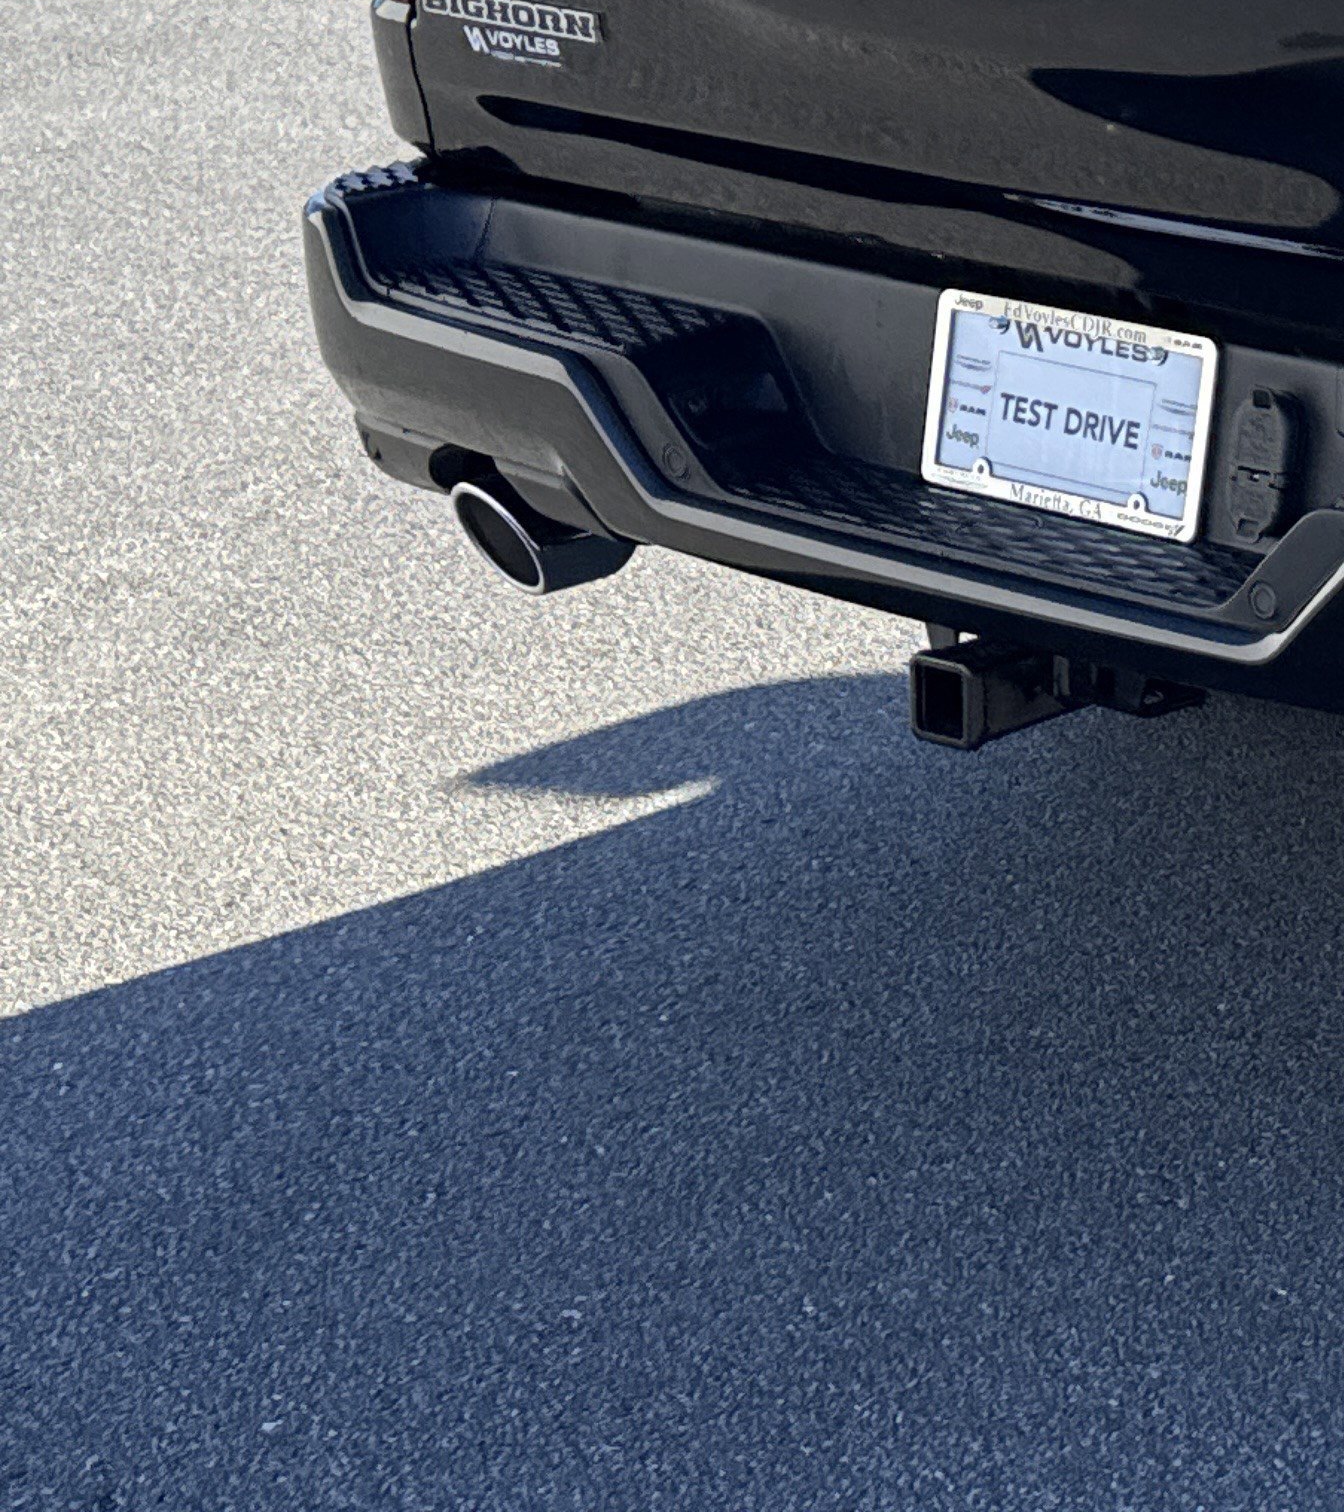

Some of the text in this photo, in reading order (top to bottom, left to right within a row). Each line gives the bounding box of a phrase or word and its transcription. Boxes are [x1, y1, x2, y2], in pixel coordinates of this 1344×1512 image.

[485, 29, 561, 56] VOYLES
[1044, 326, 1149, 363] VOYLES
[1000, 391, 1060, 431] TEST
[1063, 406, 1142, 451] DRIVE
[945, 423, 980, 449] Jeep
[1149, 469, 1188, 497] Jeep
[1079, 499, 1102, 520] GA
